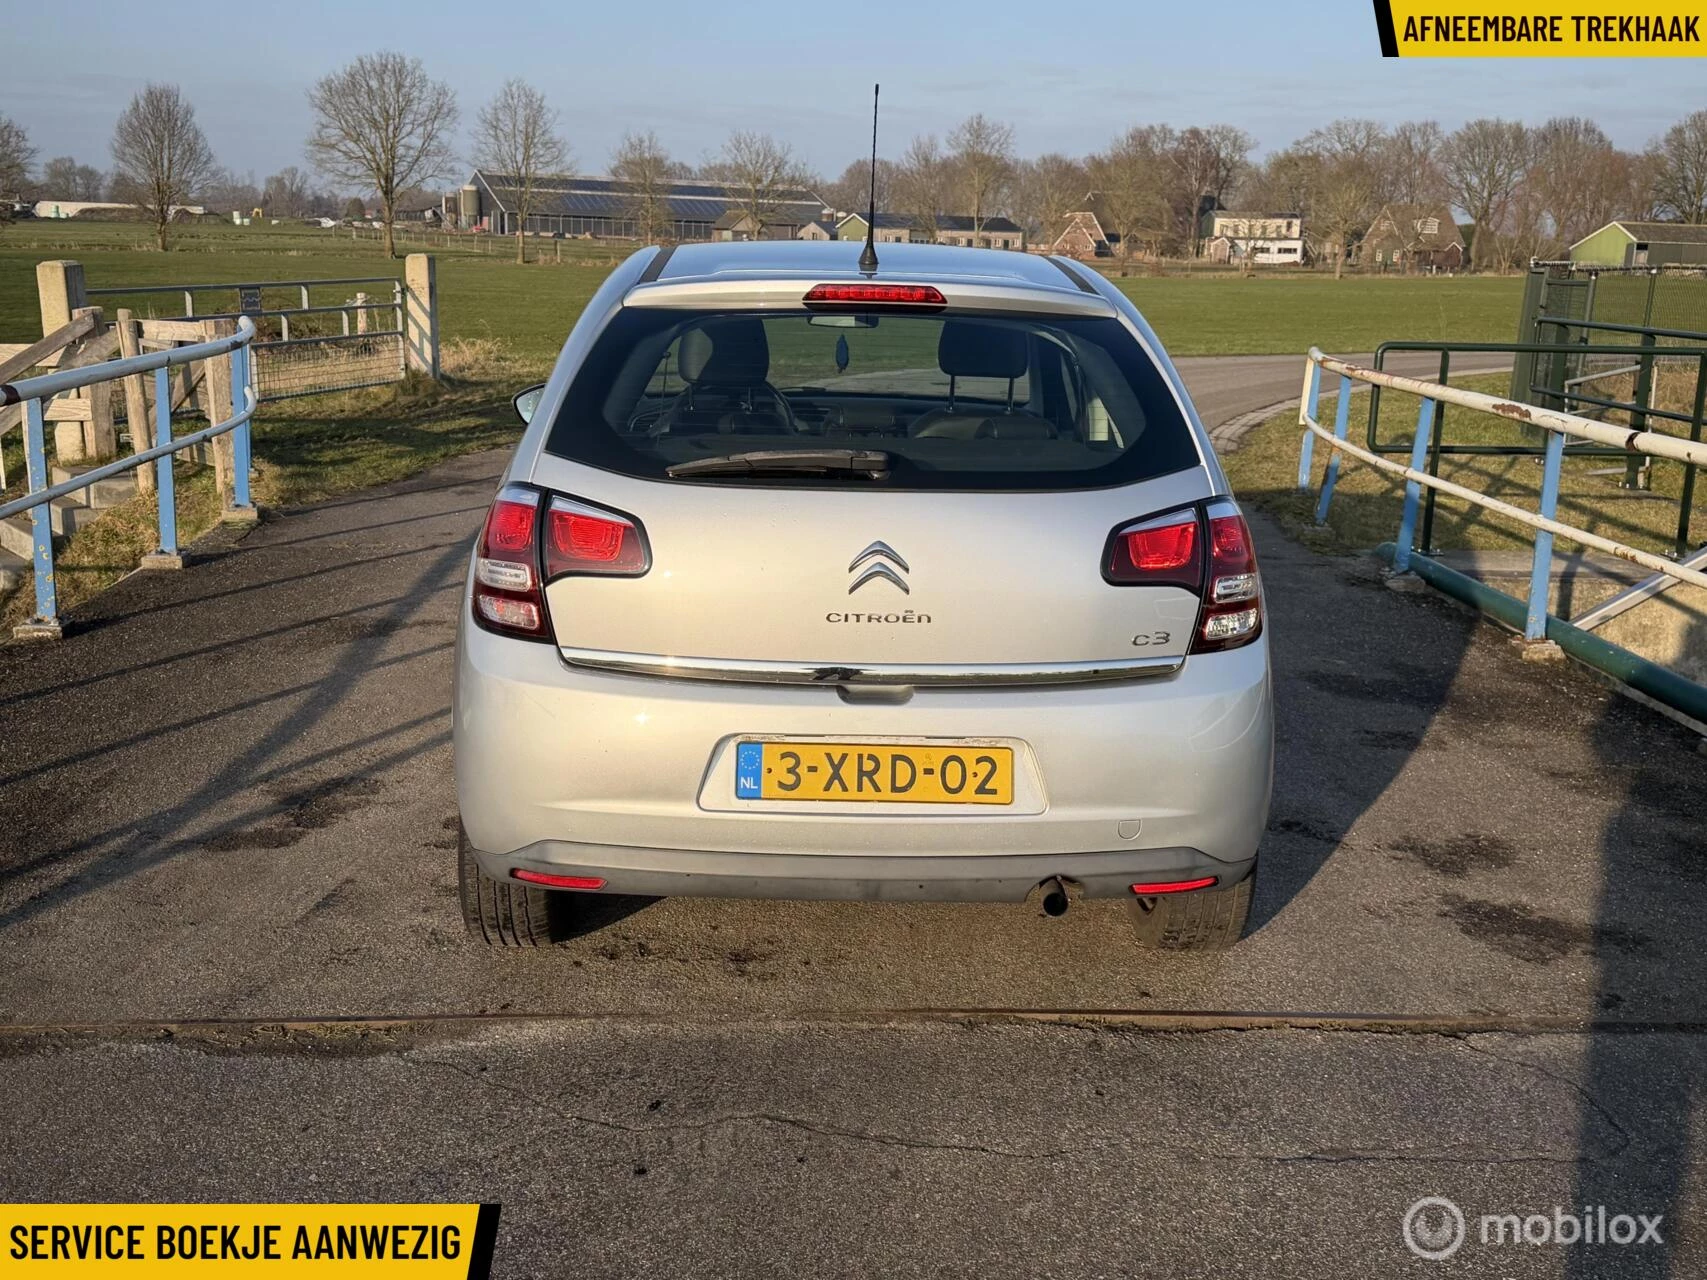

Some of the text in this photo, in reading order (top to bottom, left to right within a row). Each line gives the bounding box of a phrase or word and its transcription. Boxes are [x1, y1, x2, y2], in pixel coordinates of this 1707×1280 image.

[1132, 631, 1171, 646] C3
[777, 751, 998, 795] 3-XRD-02
[740, 776, 758, 790] NL
